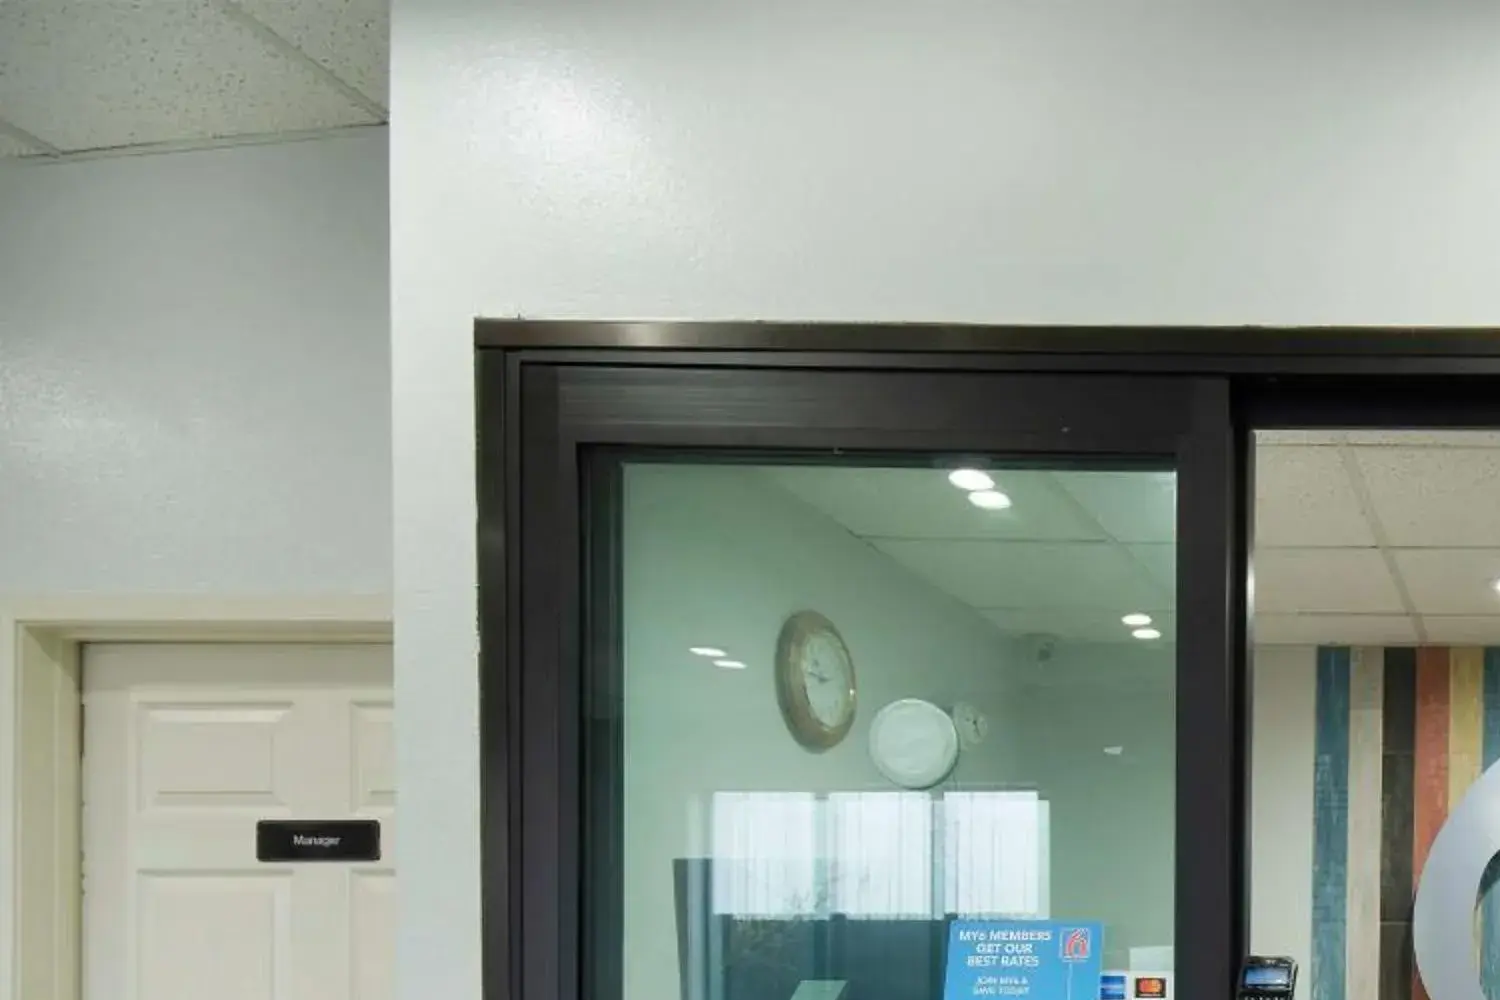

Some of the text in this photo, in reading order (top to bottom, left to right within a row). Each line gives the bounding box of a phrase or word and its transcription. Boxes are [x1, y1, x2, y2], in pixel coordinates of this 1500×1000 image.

[292, 834, 341, 848] Manager
[989, 930, 1052, 941] MEMBERS
[976, 943, 1033, 954] GET OUR
[967, 955, 1040, 967] BEST RATES
